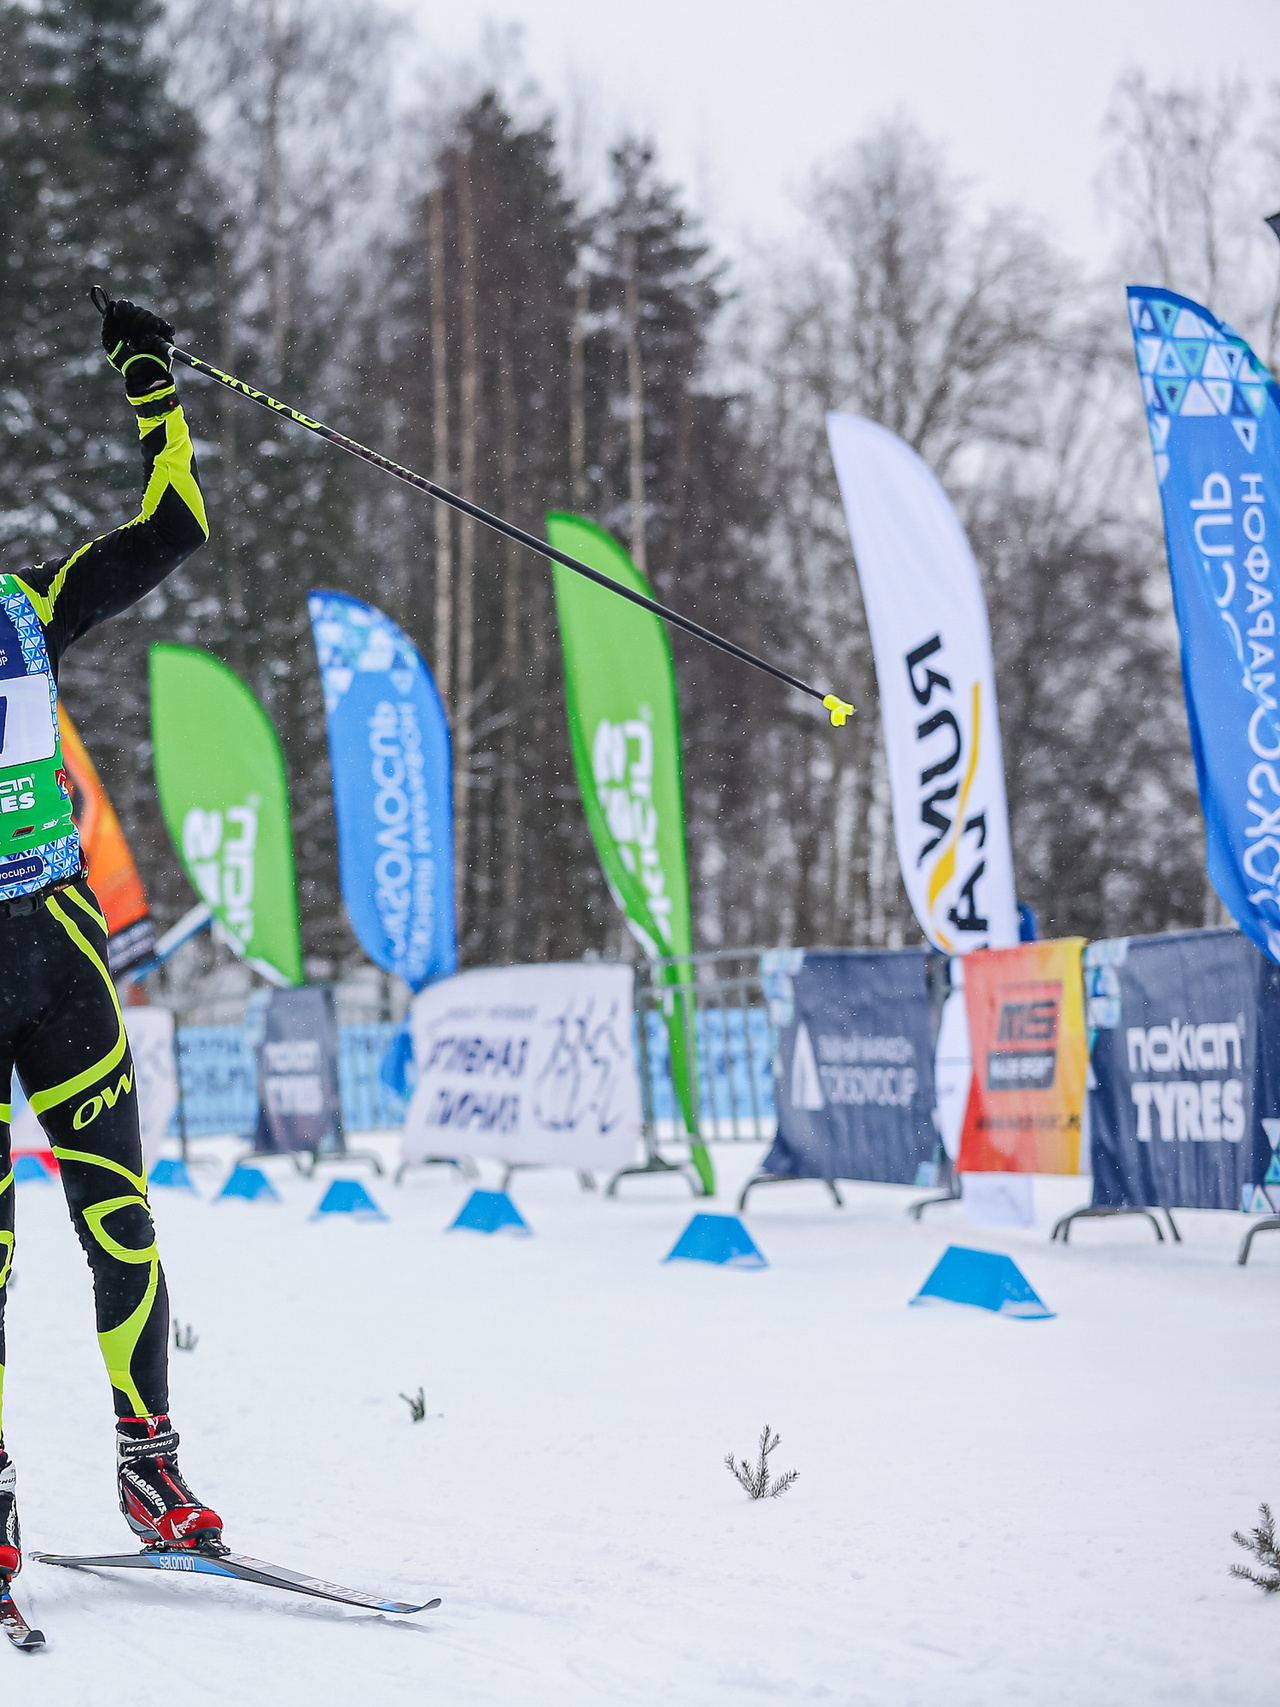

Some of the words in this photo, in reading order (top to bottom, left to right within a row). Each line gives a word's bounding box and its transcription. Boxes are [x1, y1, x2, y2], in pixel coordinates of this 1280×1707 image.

[1131, 1078, 1246, 1143] TYRES
[125, 1438, 174, 1452] MADSHUS
[159, 1556, 196, 1571] salomon
